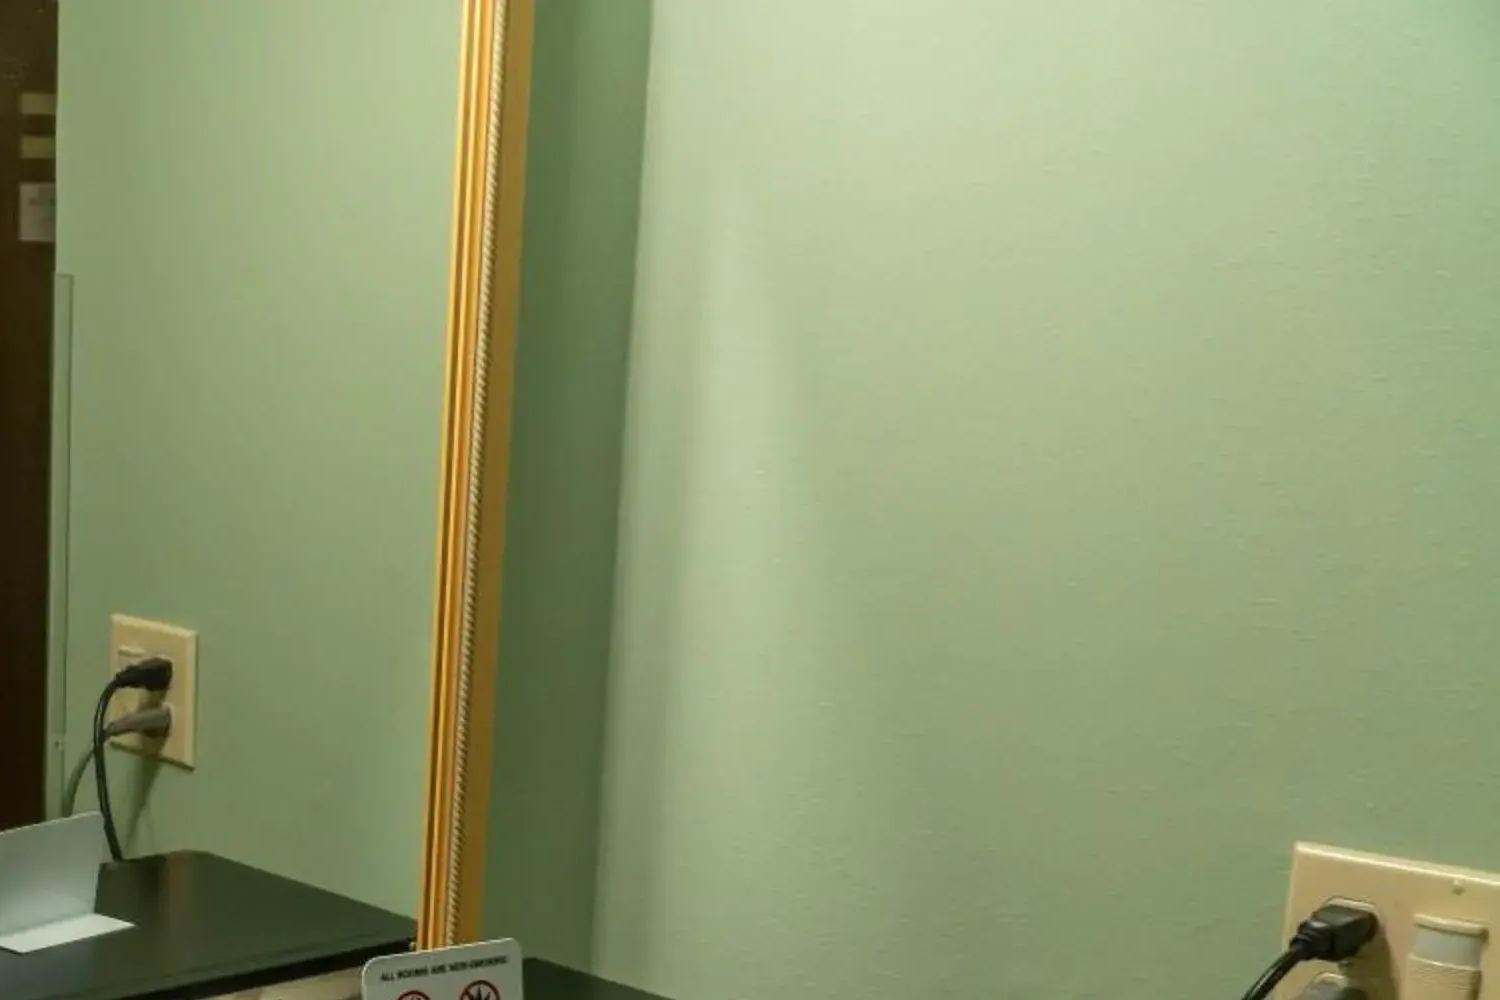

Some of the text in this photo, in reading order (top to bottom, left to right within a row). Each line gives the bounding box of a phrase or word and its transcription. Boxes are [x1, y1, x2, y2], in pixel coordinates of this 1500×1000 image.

[381, 955, 507, 981] ALL ROOMS ARE NON-SMOKING
